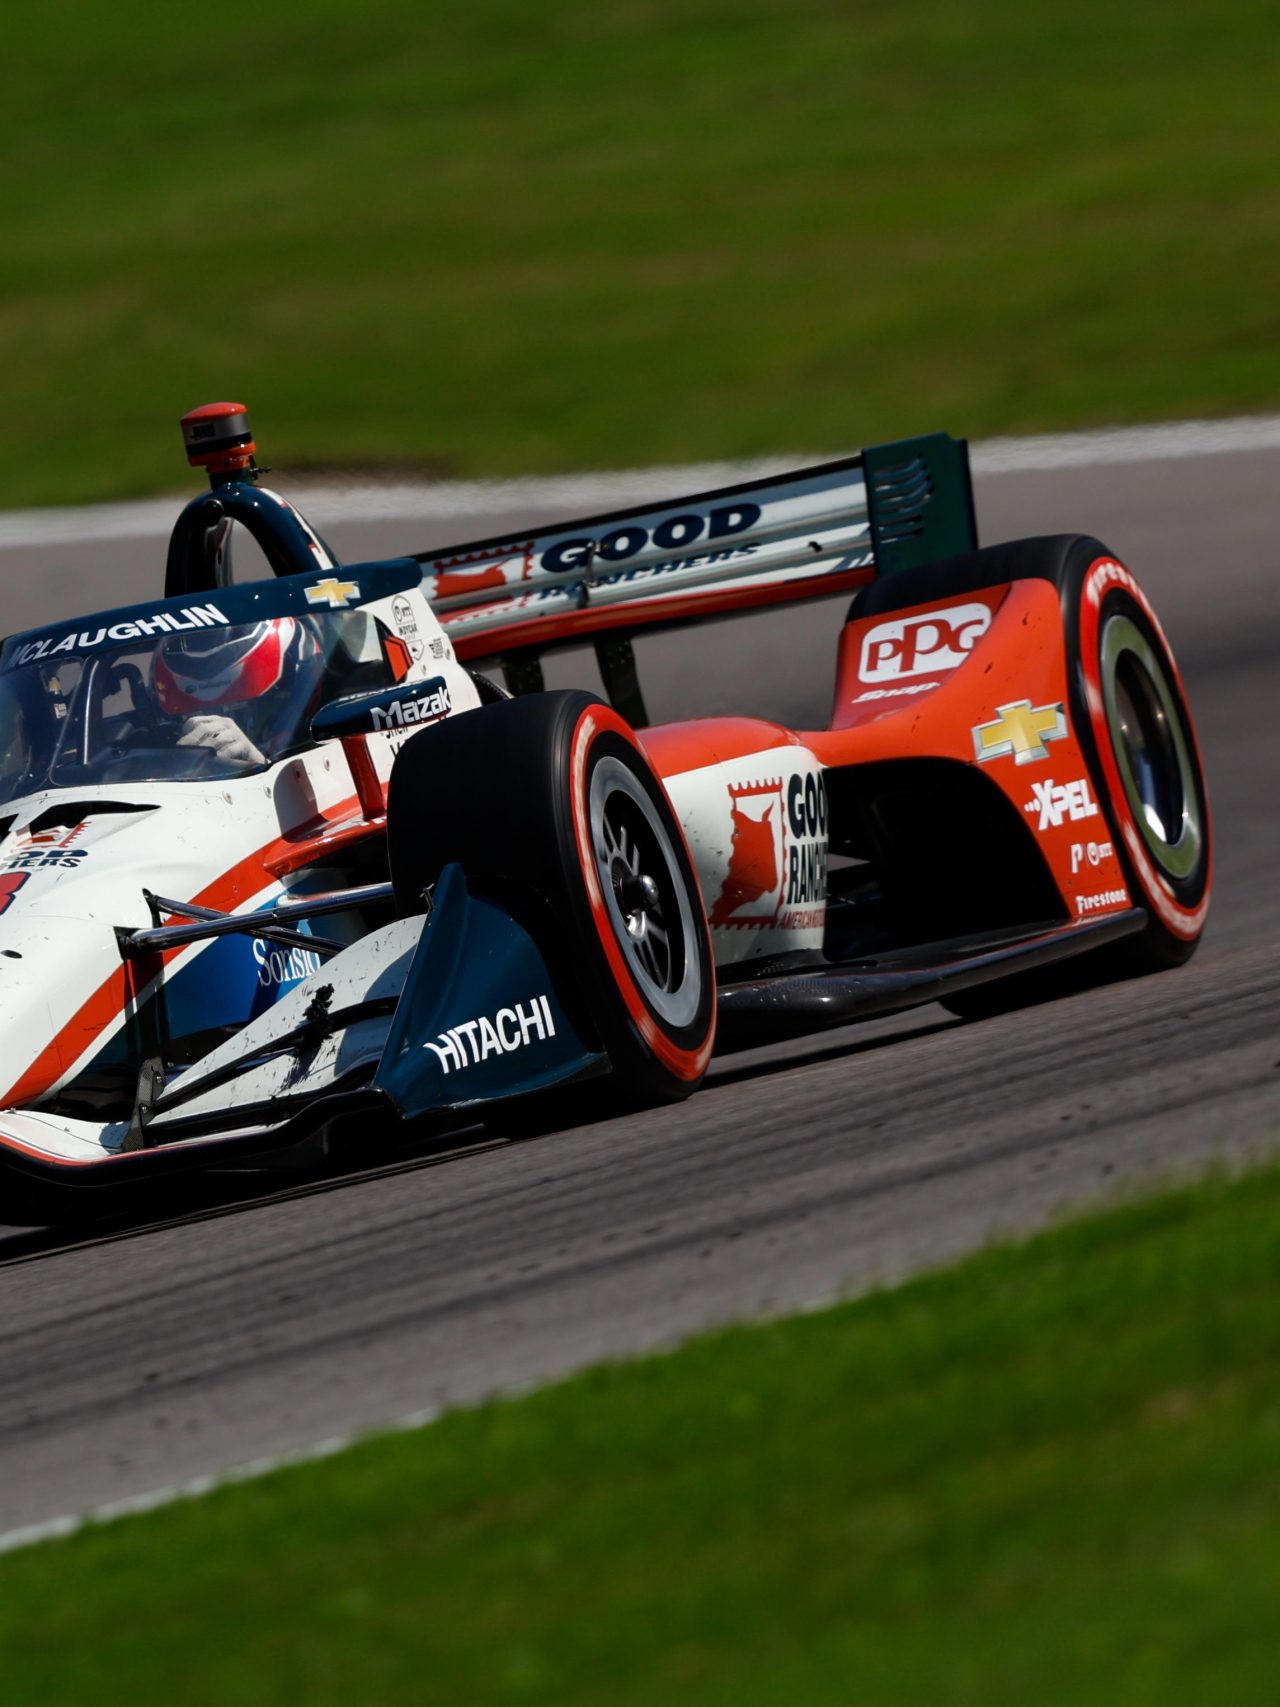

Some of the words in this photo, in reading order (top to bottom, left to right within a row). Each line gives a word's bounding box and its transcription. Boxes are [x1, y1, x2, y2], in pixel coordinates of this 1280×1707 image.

[540, 503, 761, 573] GOOD
[866, 618, 984, 673] PPG
[370, 686, 451, 732] Mazak
[787, 771, 828, 839] GOO
[1031, 779, 1099, 831] XPEL
[1076, 888, 1127, 914] Firestone
[423, 995, 556, 1074] HITACHI
